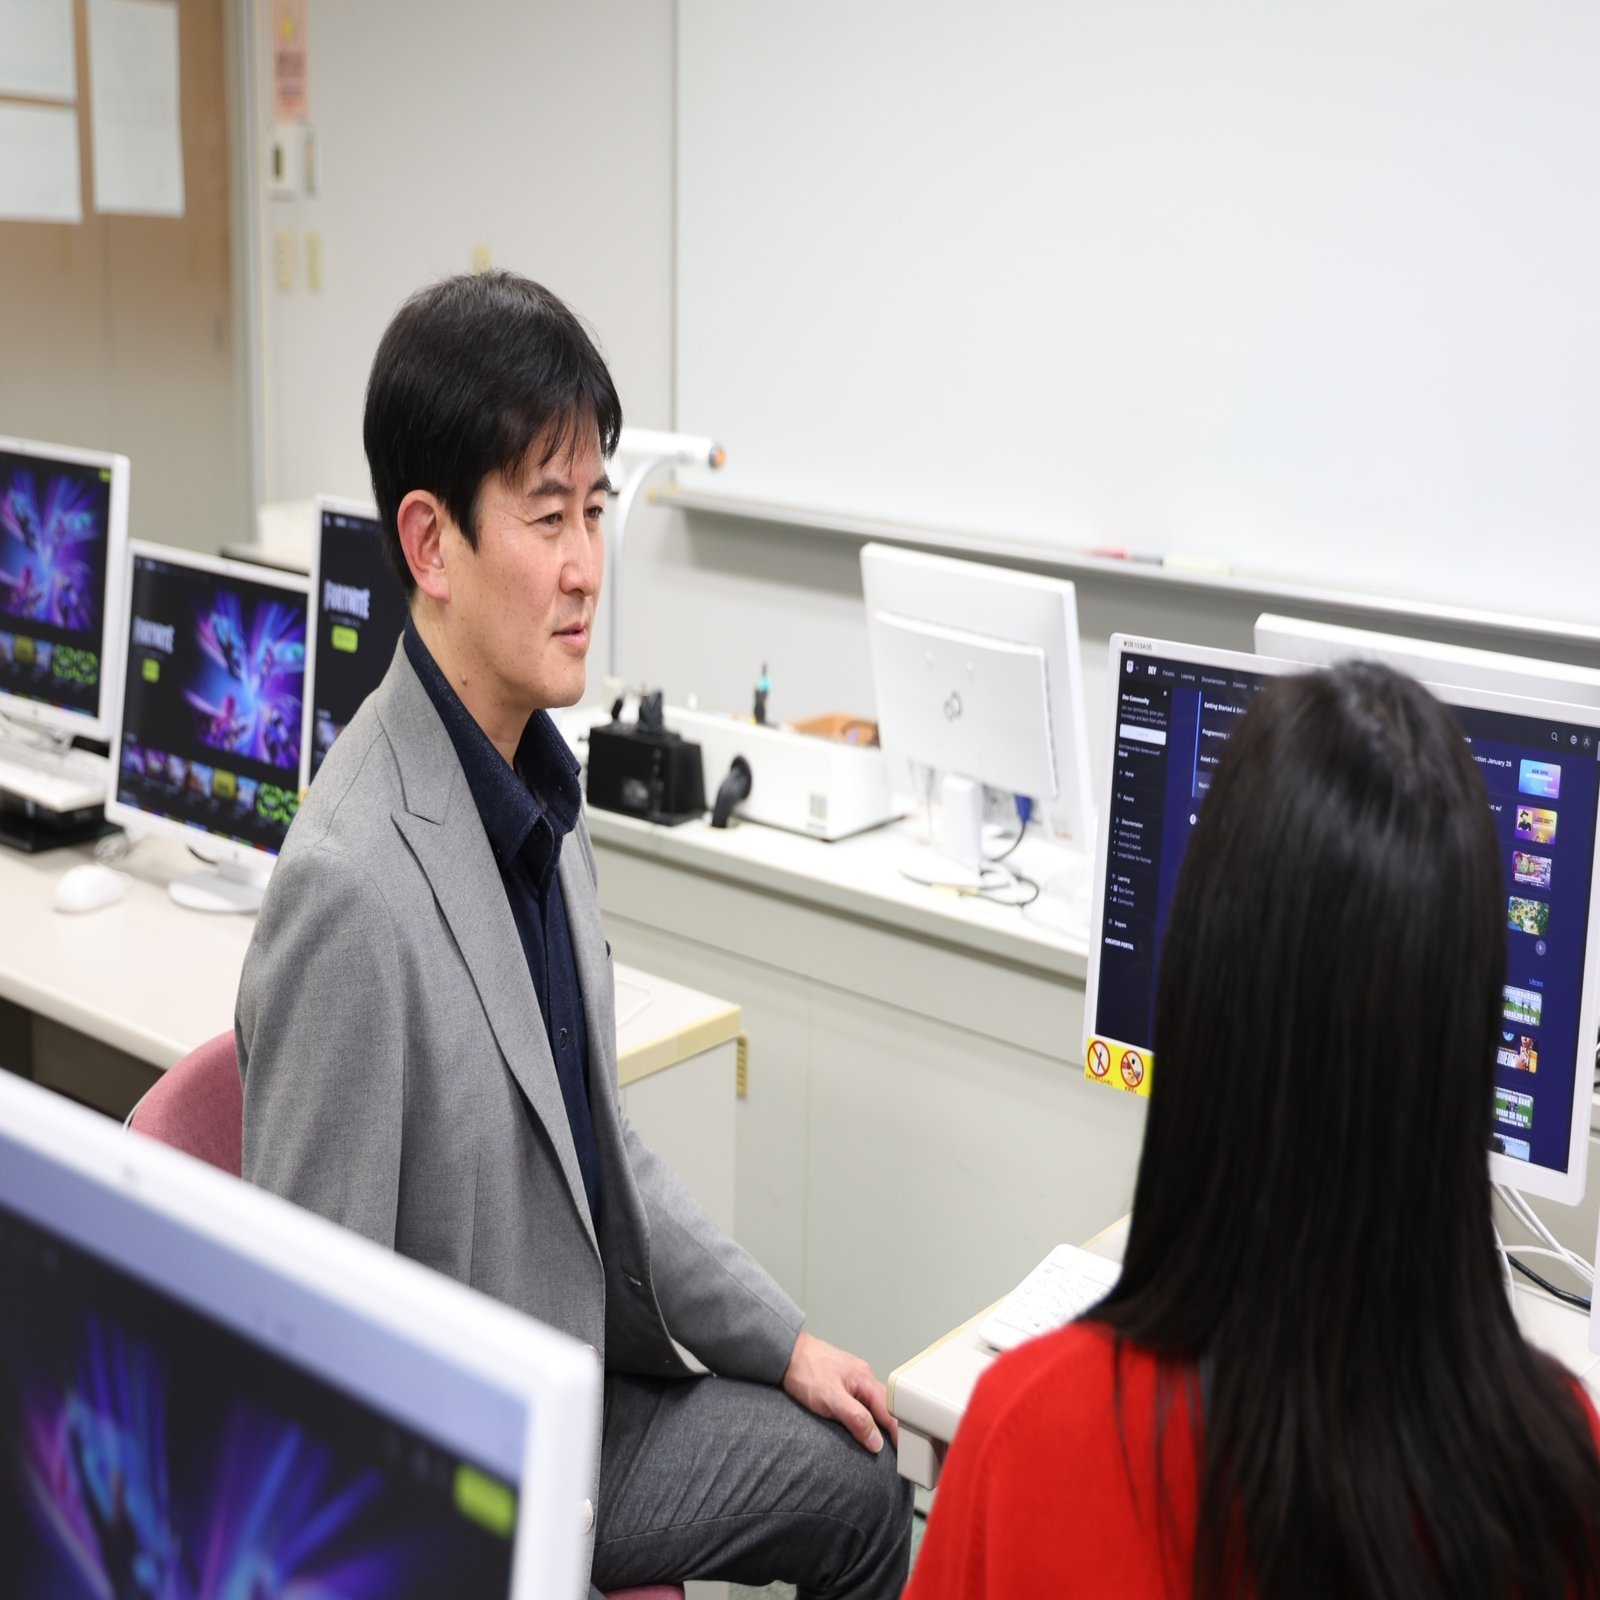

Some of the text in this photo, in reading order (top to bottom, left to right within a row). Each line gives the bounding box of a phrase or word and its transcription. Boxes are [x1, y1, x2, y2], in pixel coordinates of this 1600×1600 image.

[1181, 673, 1195, 682] Learning
[1201, 676, 1226, 686] Documentation
[1130, 695, 1150, 706] Community
[1204, 701, 1218, 711] Getting
[1218, 704, 1233, 713] Started
[1202, 728, 1227, 740] Programming
[1487, 758, 1505, 768] January
[1121, 818, 1144, 829] Documentation
